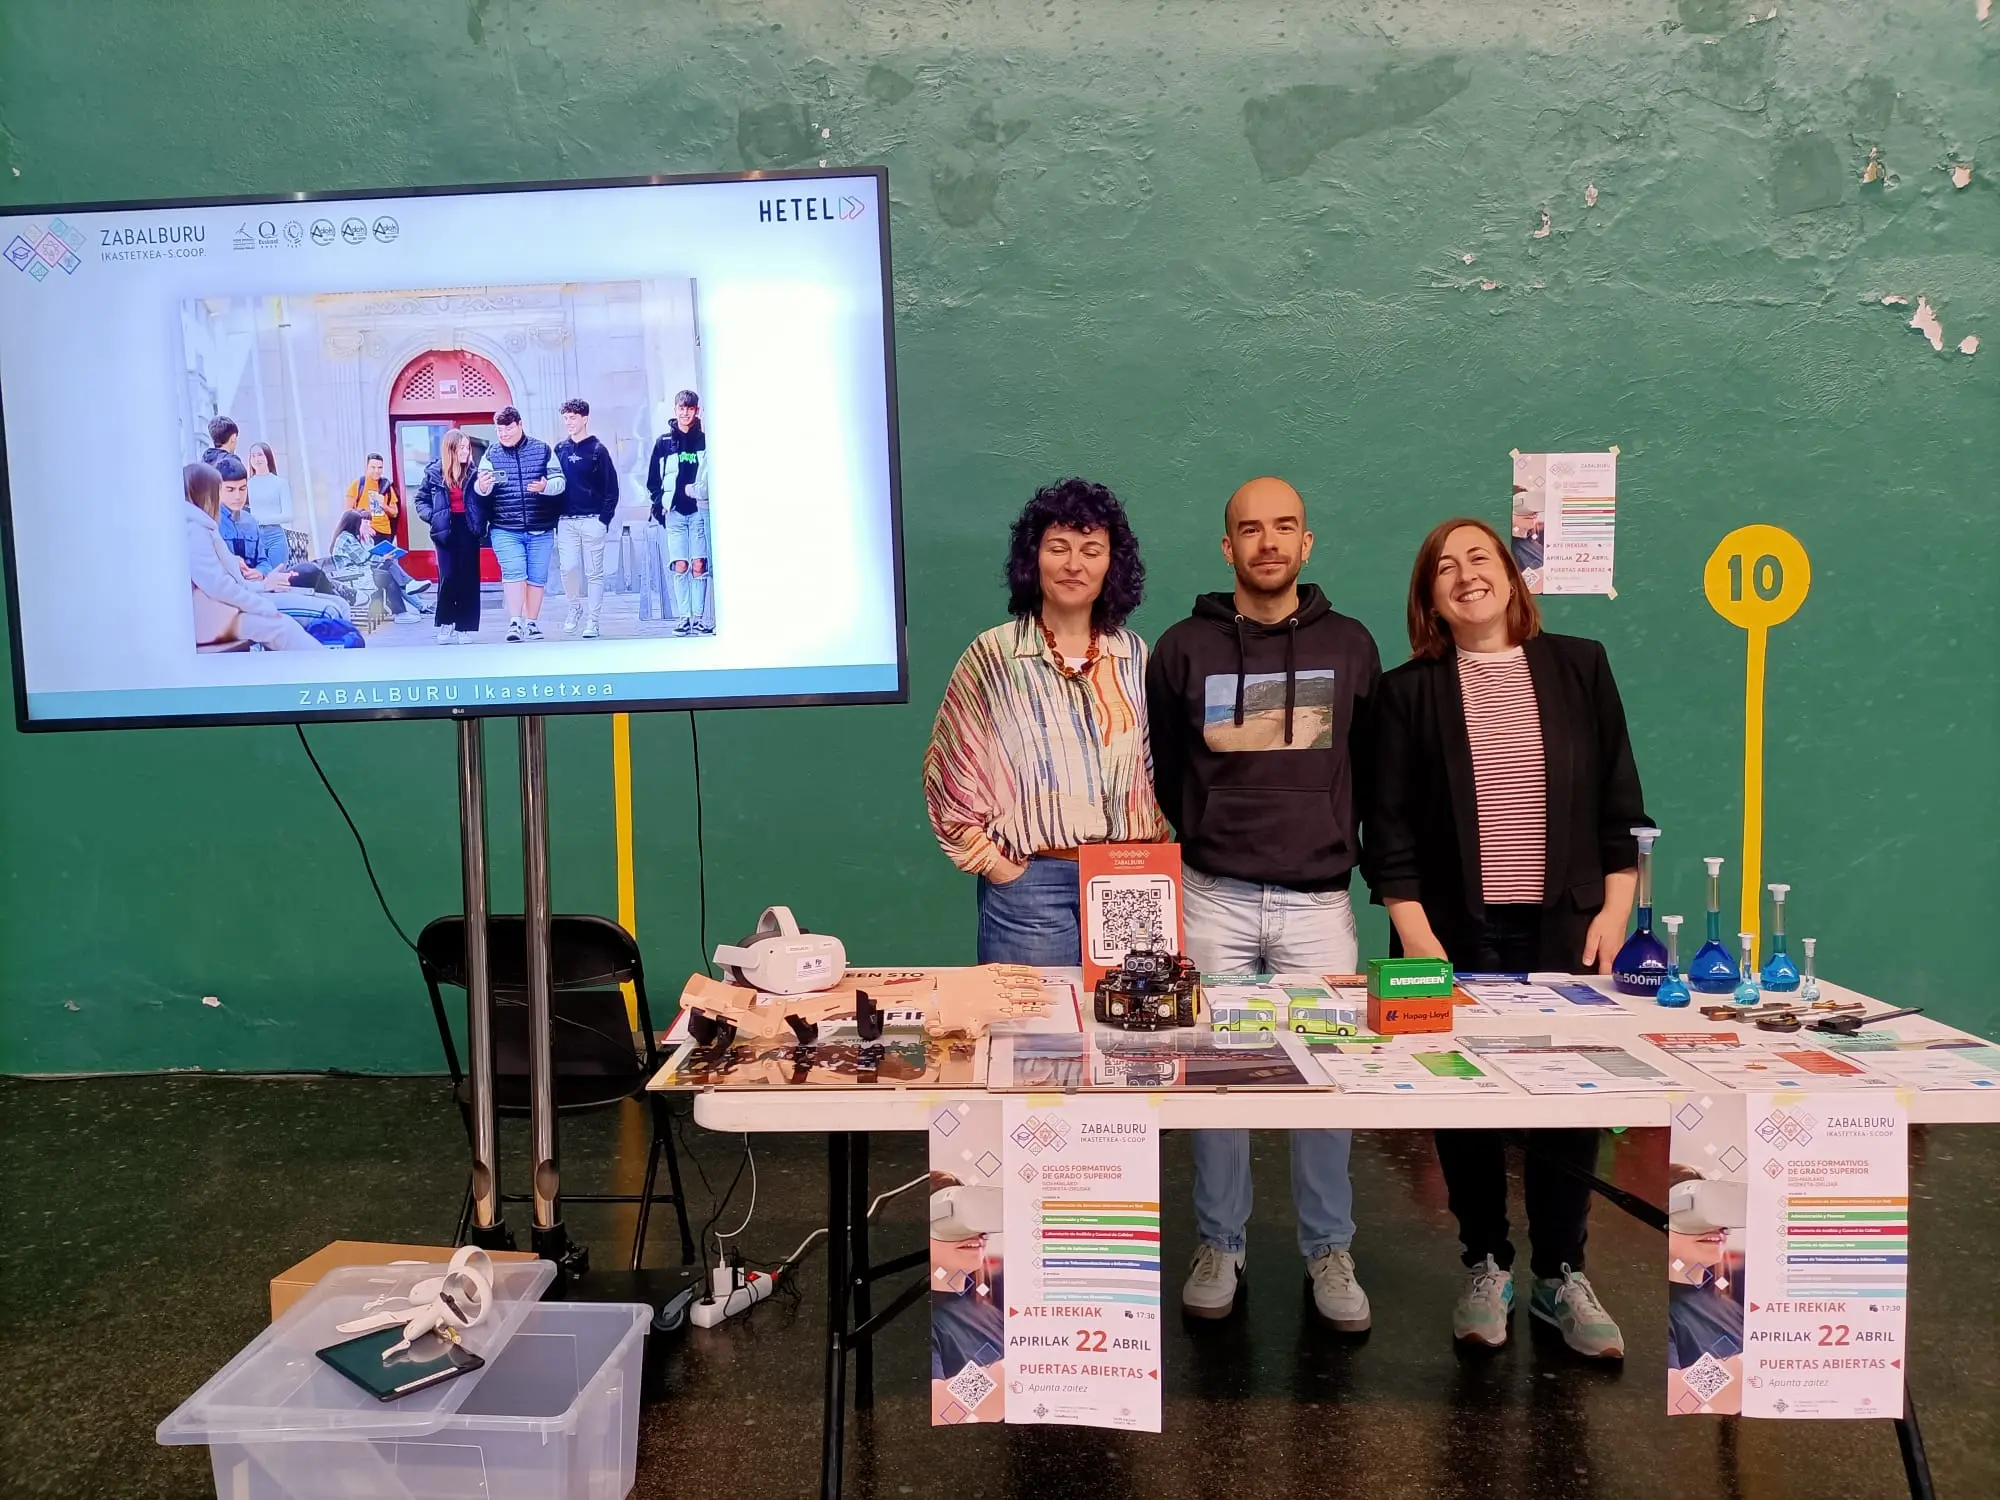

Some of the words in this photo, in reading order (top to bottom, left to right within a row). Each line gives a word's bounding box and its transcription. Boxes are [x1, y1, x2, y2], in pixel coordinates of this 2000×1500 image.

[759, 197, 834, 222] HETEL
[100, 225, 205, 246] ZABALBURU
[1575, 552, 1590, 563] 22
[1727, 554, 1784, 602] 10
[299, 686, 459, 706] ZABALBURU
[474, 682, 614, 700] Ikastetxea
[1389, 976, 1445, 986] EVERGREEN
[1623, 972, 1661, 986] 500ml
[1403, 1010, 1450, 1020] Hapag-Lloyd
[1081, 1123, 1147, 1134] ZABALBURU
[1826, 1117, 1895, 1128] ZABALBURU
[1083, 1172, 1122, 1180] SUPERIOR
[1024, 1306, 1048, 1317] ATE
[1051, 1306, 1102, 1317] IREKIAK
[1136, 1311, 1155, 1320] 17:30
[1765, 1302, 1790, 1313] ATE
[1794, 1302, 1846, 1313] IREKIAK
[1009, 1335, 1070, 1347] APIRILAK
[1075, 1329, 1108, 1353] 22
[1112, 1338, 1151, 1351] ABRIL
[1750, 1331, 1812, 1342] APIRILAK
[1817, 1324, 1850, 1346] 22
[1855, 1331, 1895, 1342] ABRIL
[1760, 1359, 1819, 1370] PUERTAS
[1822, 1358, 1886, 1369] ABIERTAS
[1019, 1364, 1078, 1375] PUERTAS
[1081, 1365, 1144, 1379] ABIERTAS
[1028, 1383, 1060, 1394] Apunta
[1061, 1383, 1088, 1393] zaitez
[1769, 1378, 1801, 1389] Apunta
[1802, 1378, 1829, 1388] zaitez
